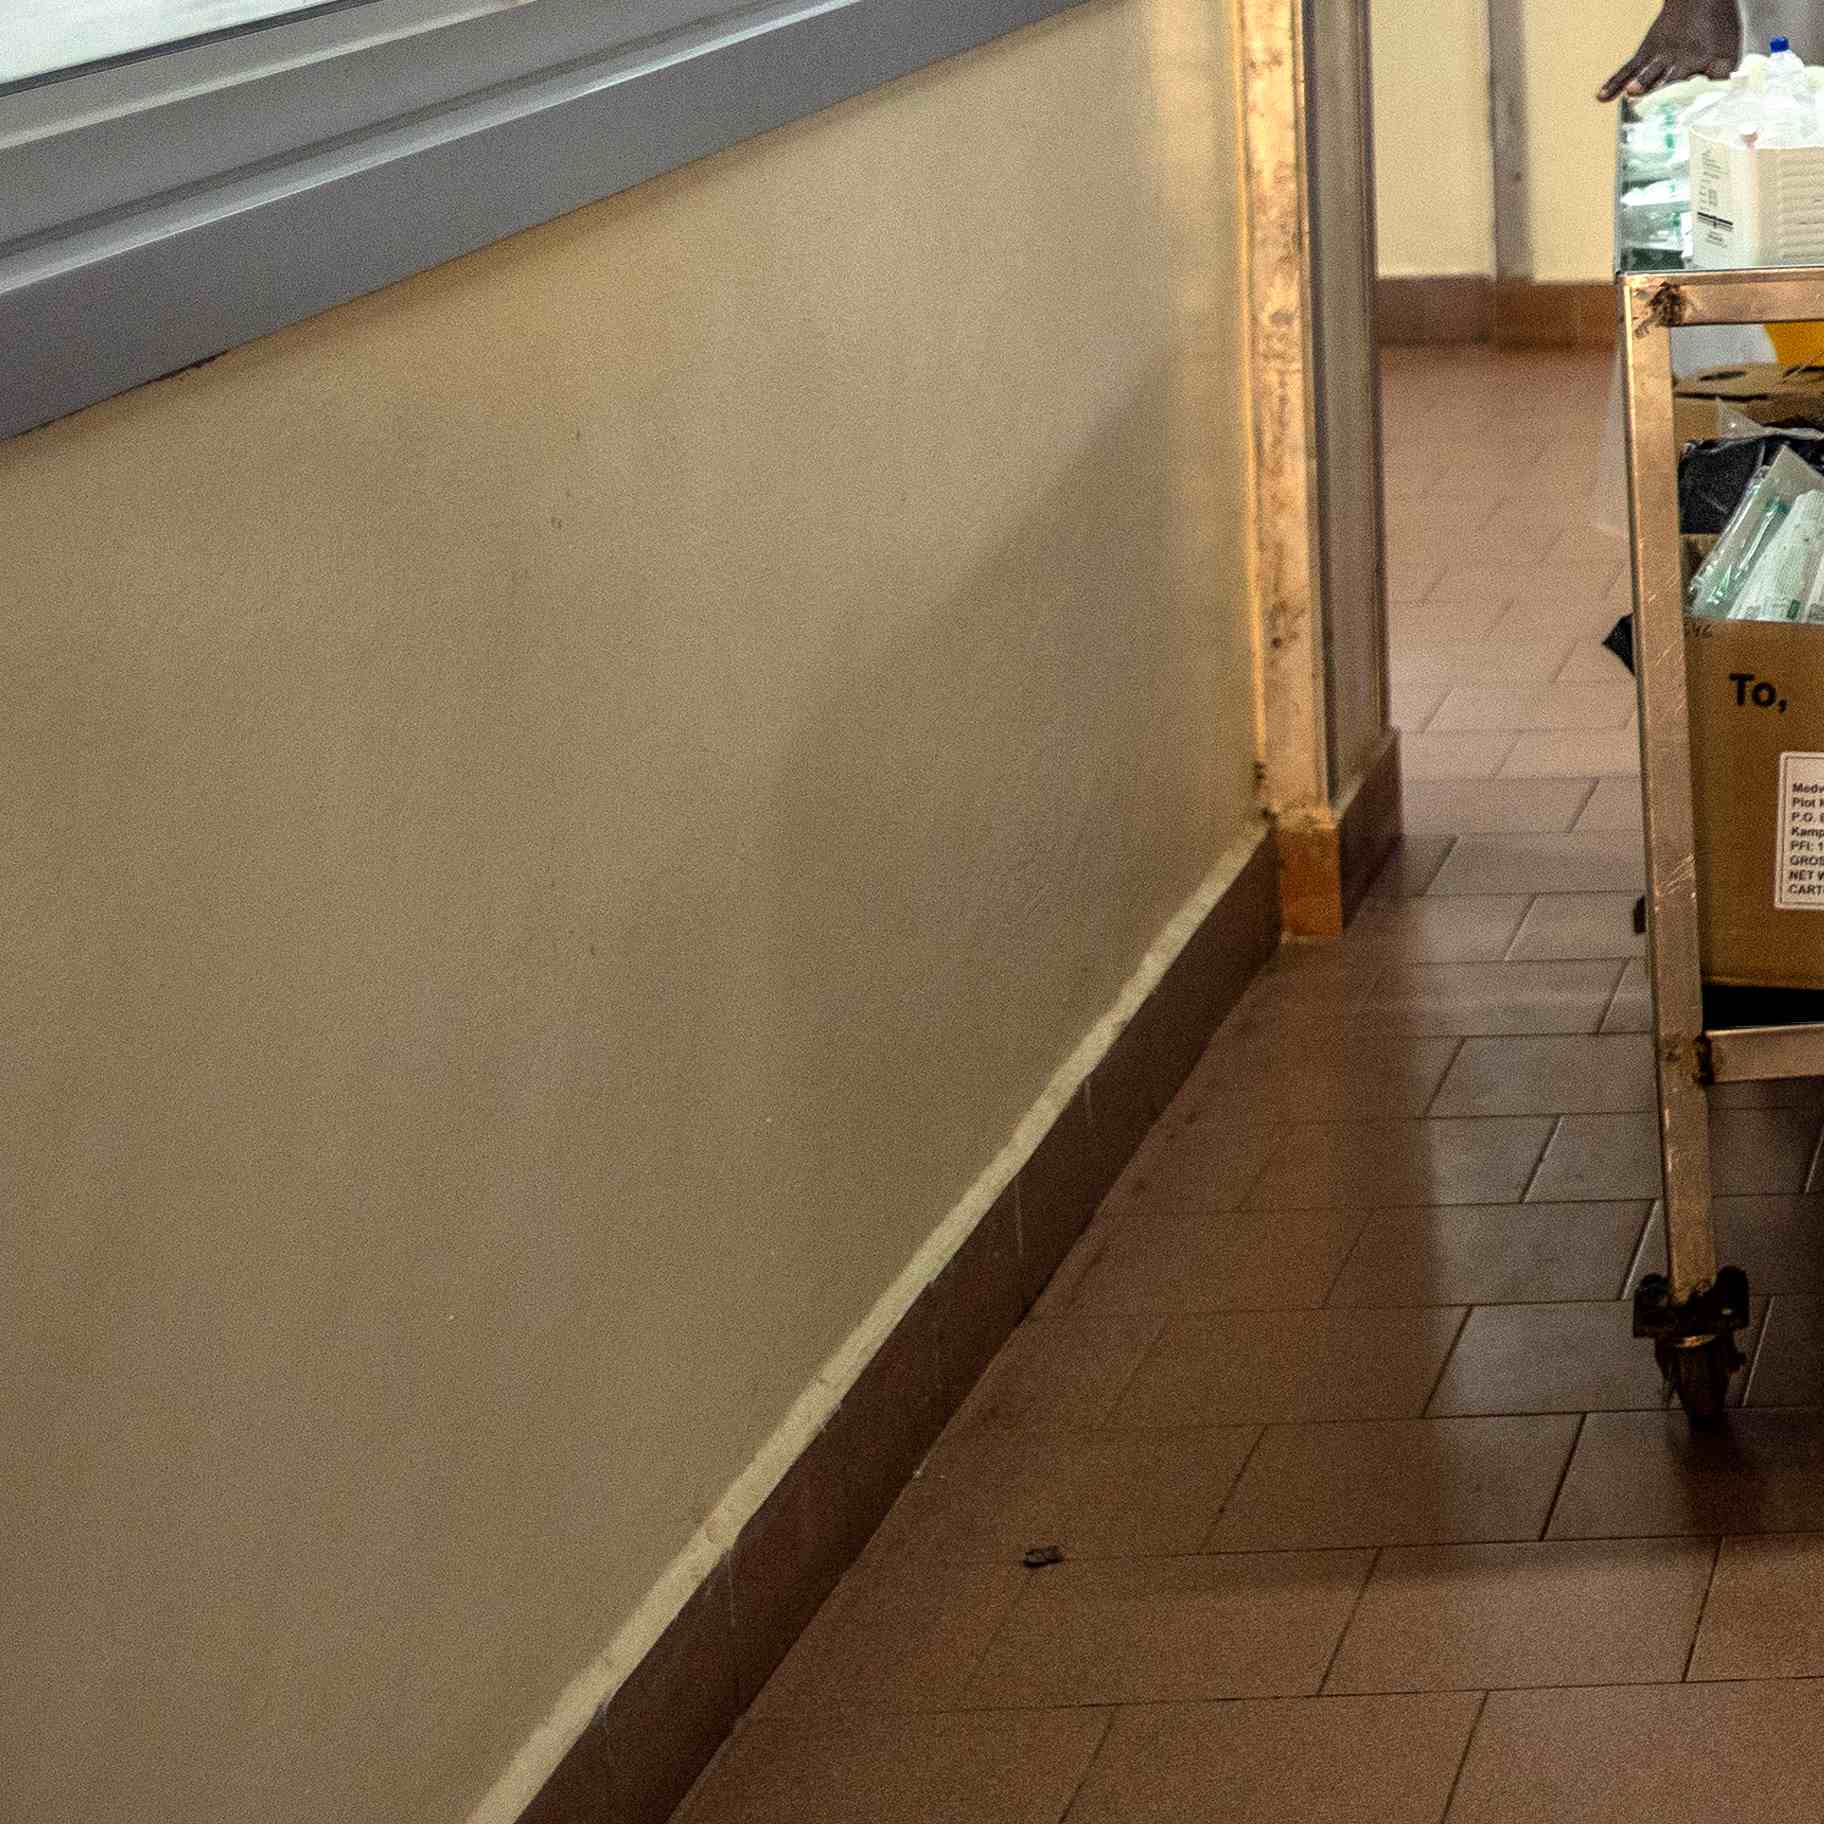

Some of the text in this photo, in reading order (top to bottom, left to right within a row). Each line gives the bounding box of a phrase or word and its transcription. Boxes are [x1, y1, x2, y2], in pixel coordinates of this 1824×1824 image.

[1728, 673, 1788, 714] To,
[1792, 797, 1816, 808] Plot
[1789, 870, 1815, 881] NET
